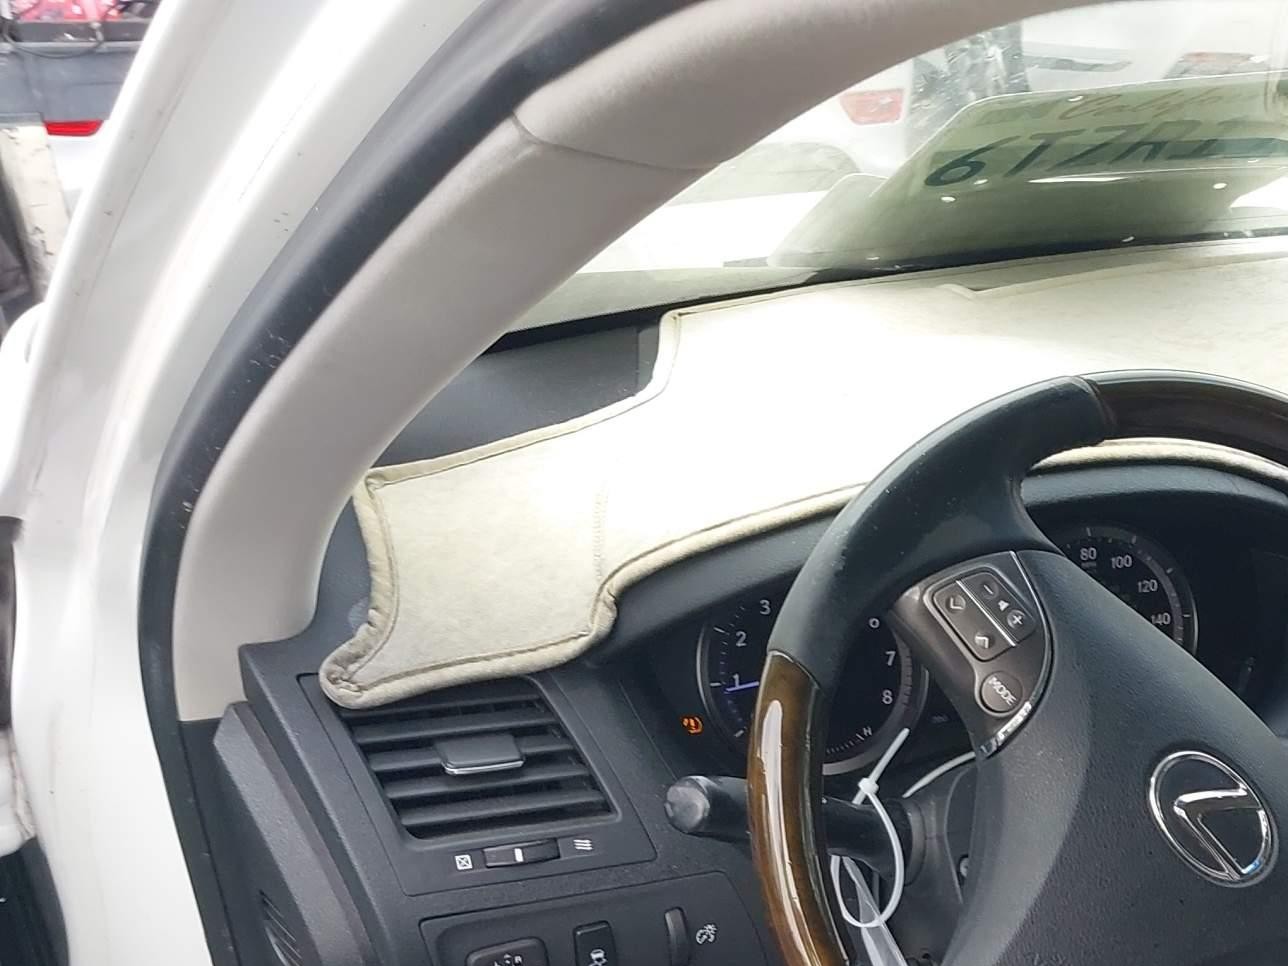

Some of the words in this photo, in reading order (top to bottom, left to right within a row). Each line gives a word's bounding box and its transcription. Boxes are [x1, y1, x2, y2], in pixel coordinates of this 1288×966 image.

[1080, 547, 1097, 560] 80
[1111, 555, 1132, 569] 100
[1138, 580, 1158, 593] 120
[760, 599, 770, 614] 3
[1151, 613, 1171, 625] 140
[736, 631, 746, 646] 2
[885, 651, 896, 666] 7
[733, 673, 741, 688] 1
[882, 690, 893, 705] 8
[988, 677, 1017, 706] MODE
[515, 955, 522, 963] R
